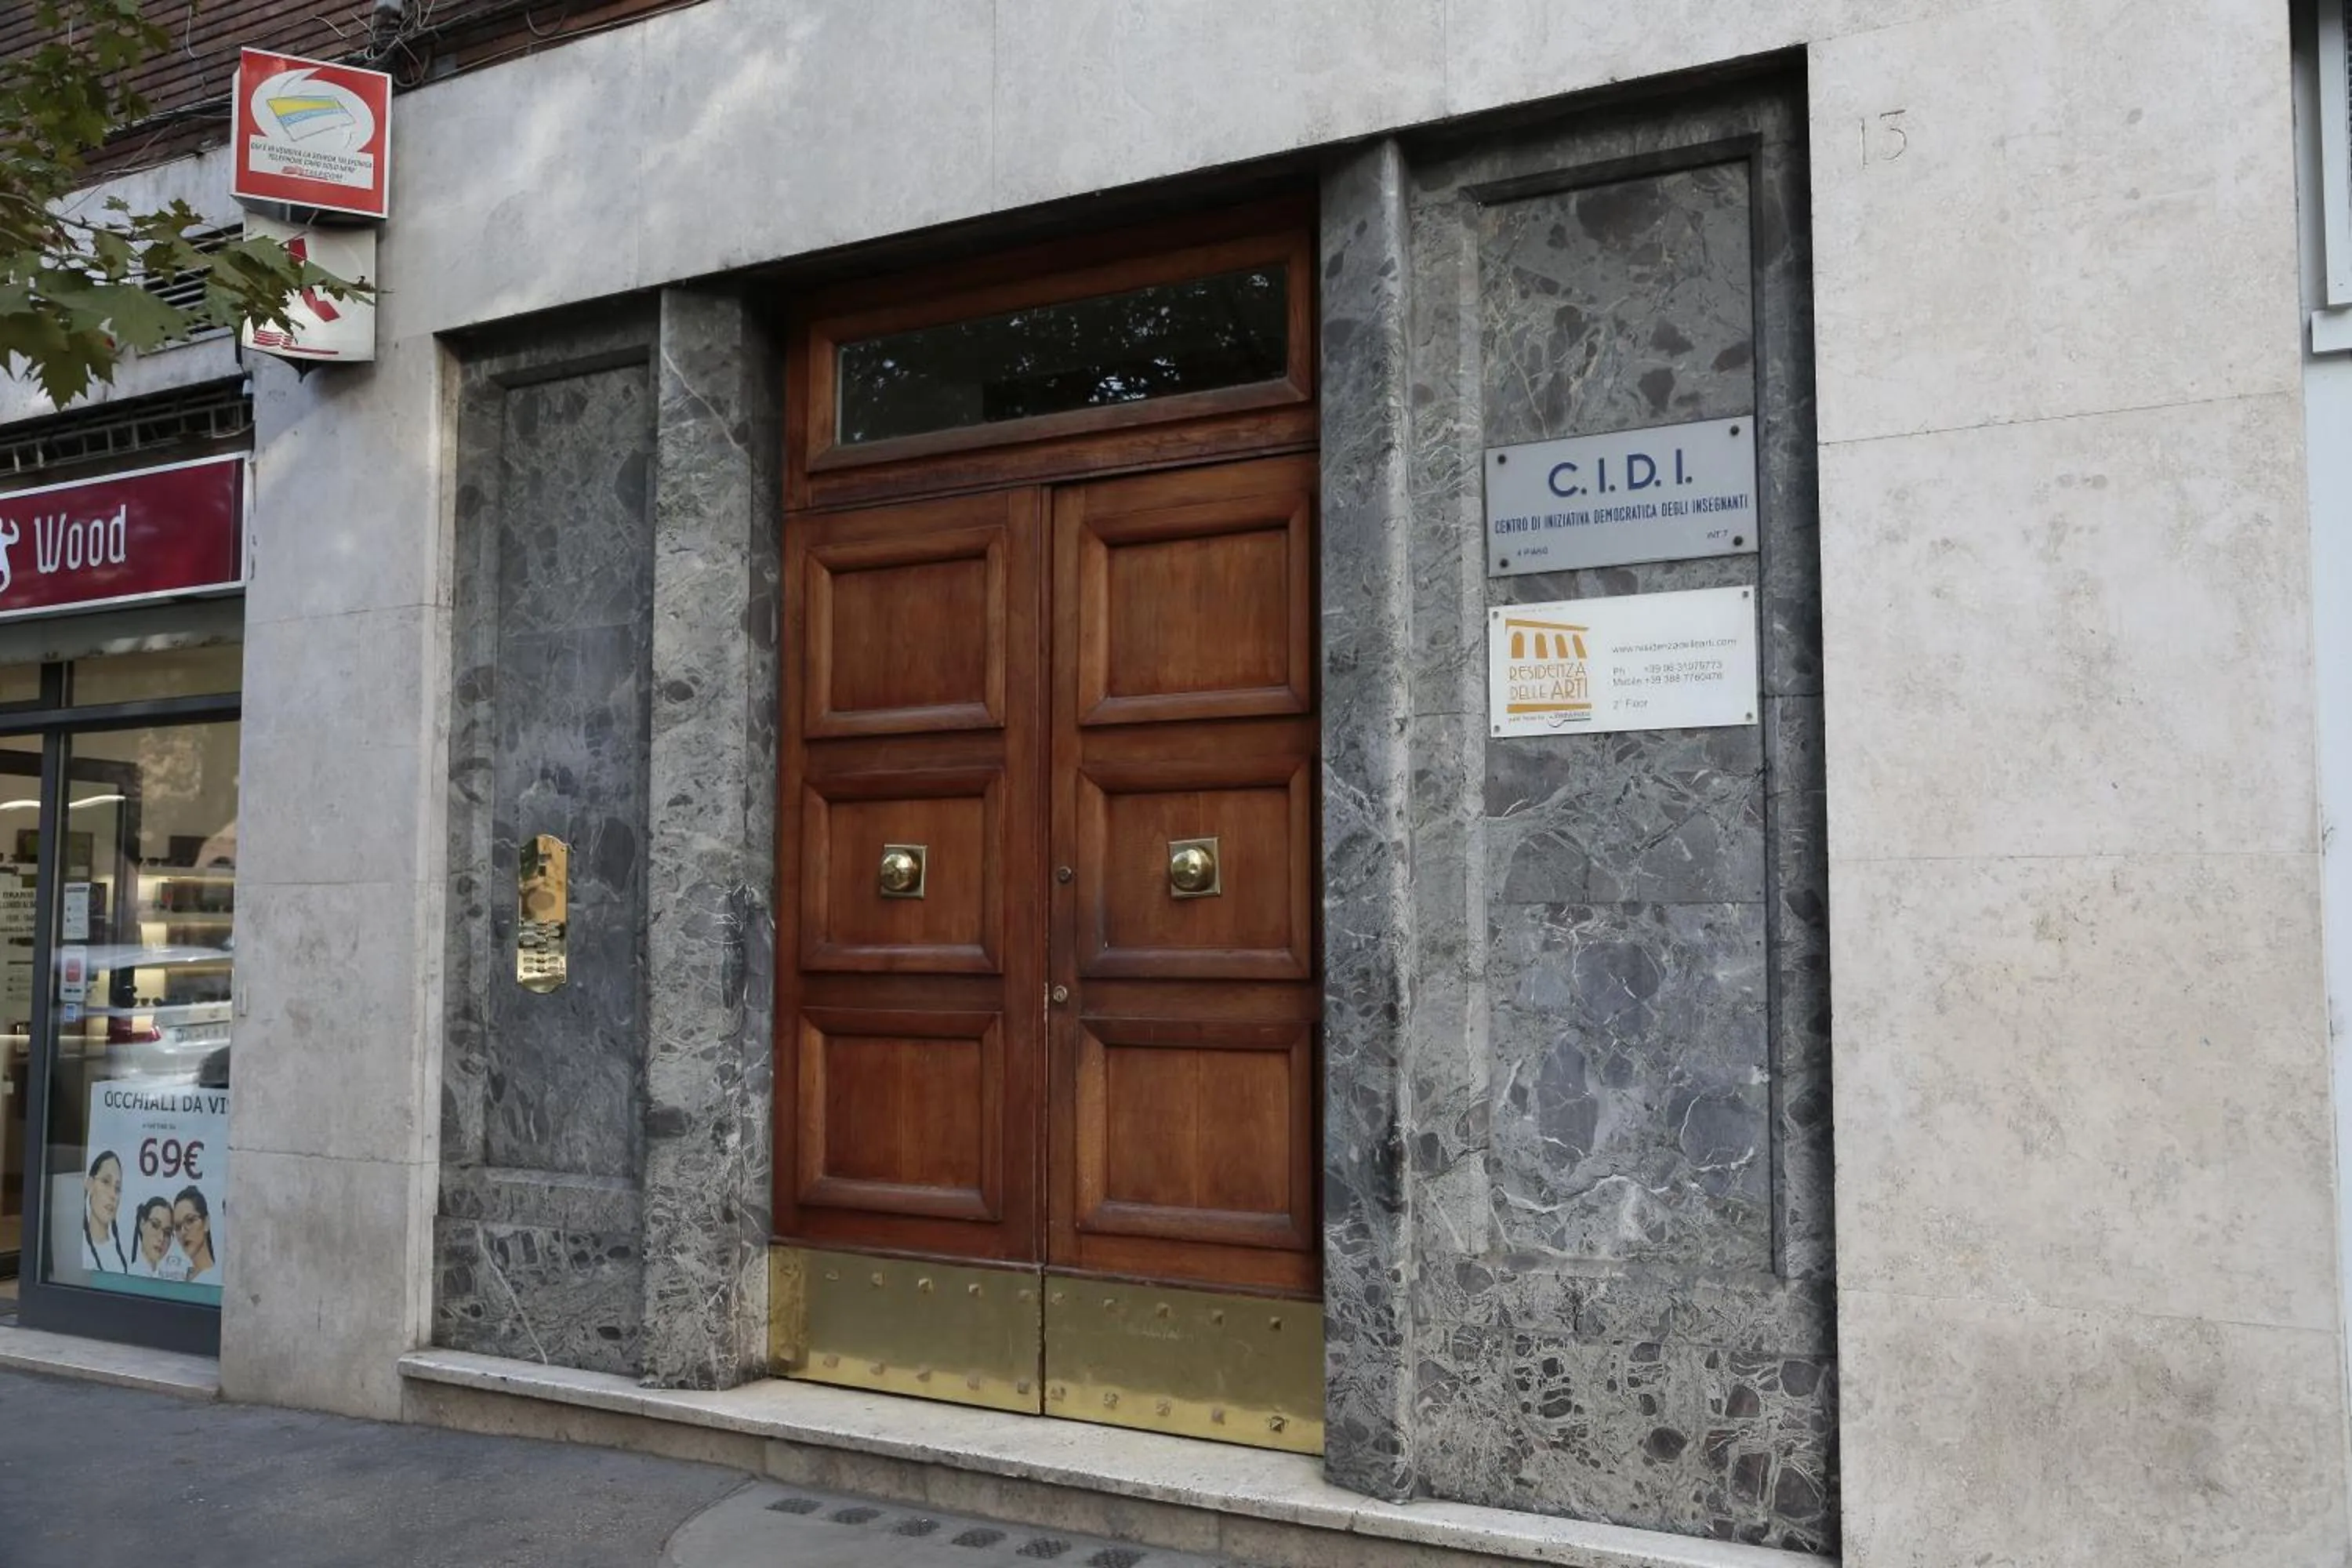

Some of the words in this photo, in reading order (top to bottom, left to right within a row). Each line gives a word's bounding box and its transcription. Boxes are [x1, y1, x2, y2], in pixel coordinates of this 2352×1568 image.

[1548, 449, 1693, 498] C.I.D.I.
[1495, 517, 1528, 534] CENTRO
[1531, 516, 1541, 531] DI
[1544, 511, 1590, 530] INIZIATIVA
[1594, 504, 1657, 524] DEMOCRATICA
[1661, 499, 1689, 517] DEGLI
[1693, 494, 1748, 514] INSEGNANTI
[34, 504, 126, 573] Wood
[1509, 662, 1587, 681] RESIDENZA
[1510, 684, 1548, 700] DELLE
[1552, 676, 1588, 700] ARTI
[104, 1091, 176, 1112] OCCHIALI
[183, 1095, 203, 1113] DA
[208, 1097, 229, 1114] VI
[139, 1138, 205, 1180] 69€
